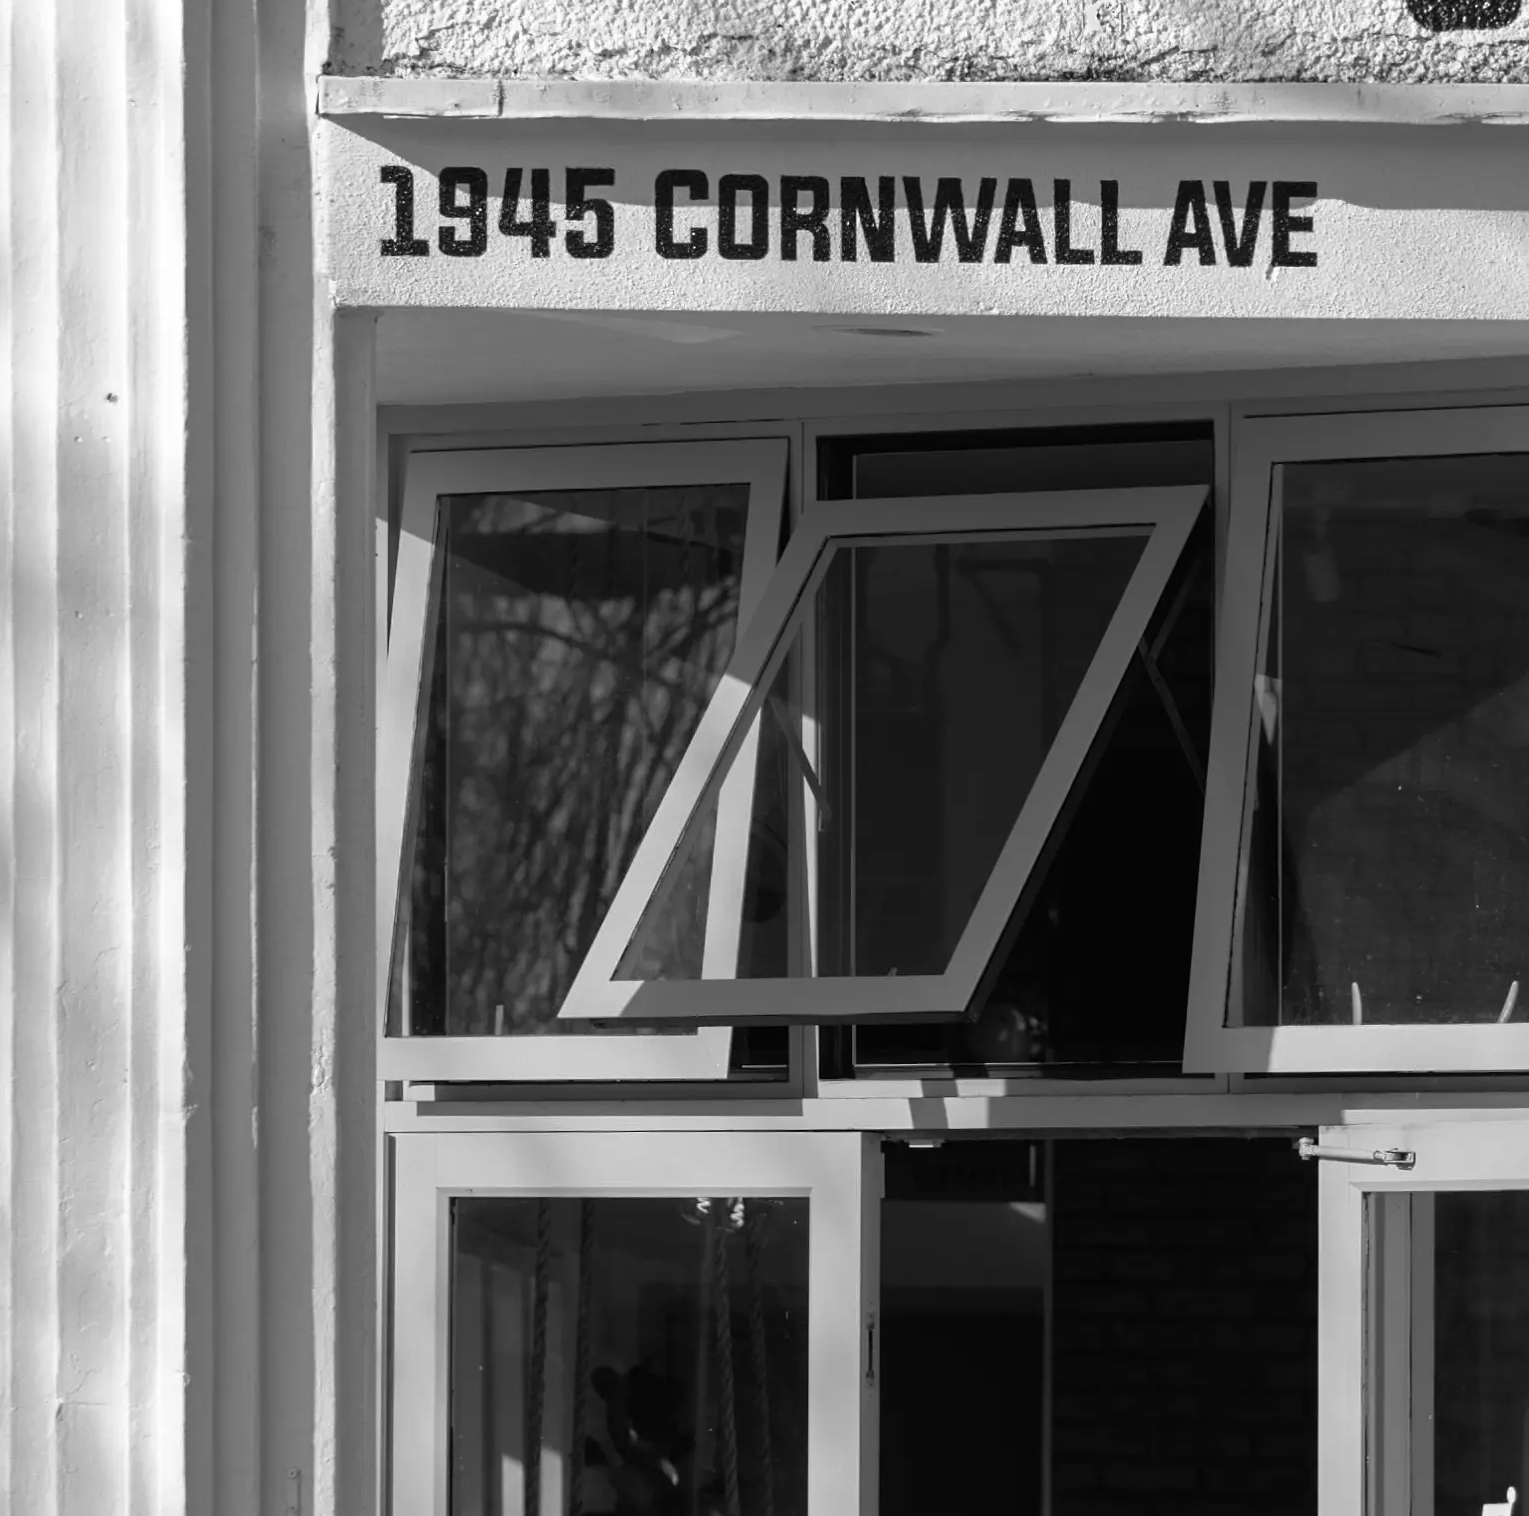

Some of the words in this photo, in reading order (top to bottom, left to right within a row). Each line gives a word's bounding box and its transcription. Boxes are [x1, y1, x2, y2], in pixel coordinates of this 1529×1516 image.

[379, 165, 617, 260] 1945
[653, 167, 1143, 267] CORNWALL
[1162, 180, 1319, 269] AVE
